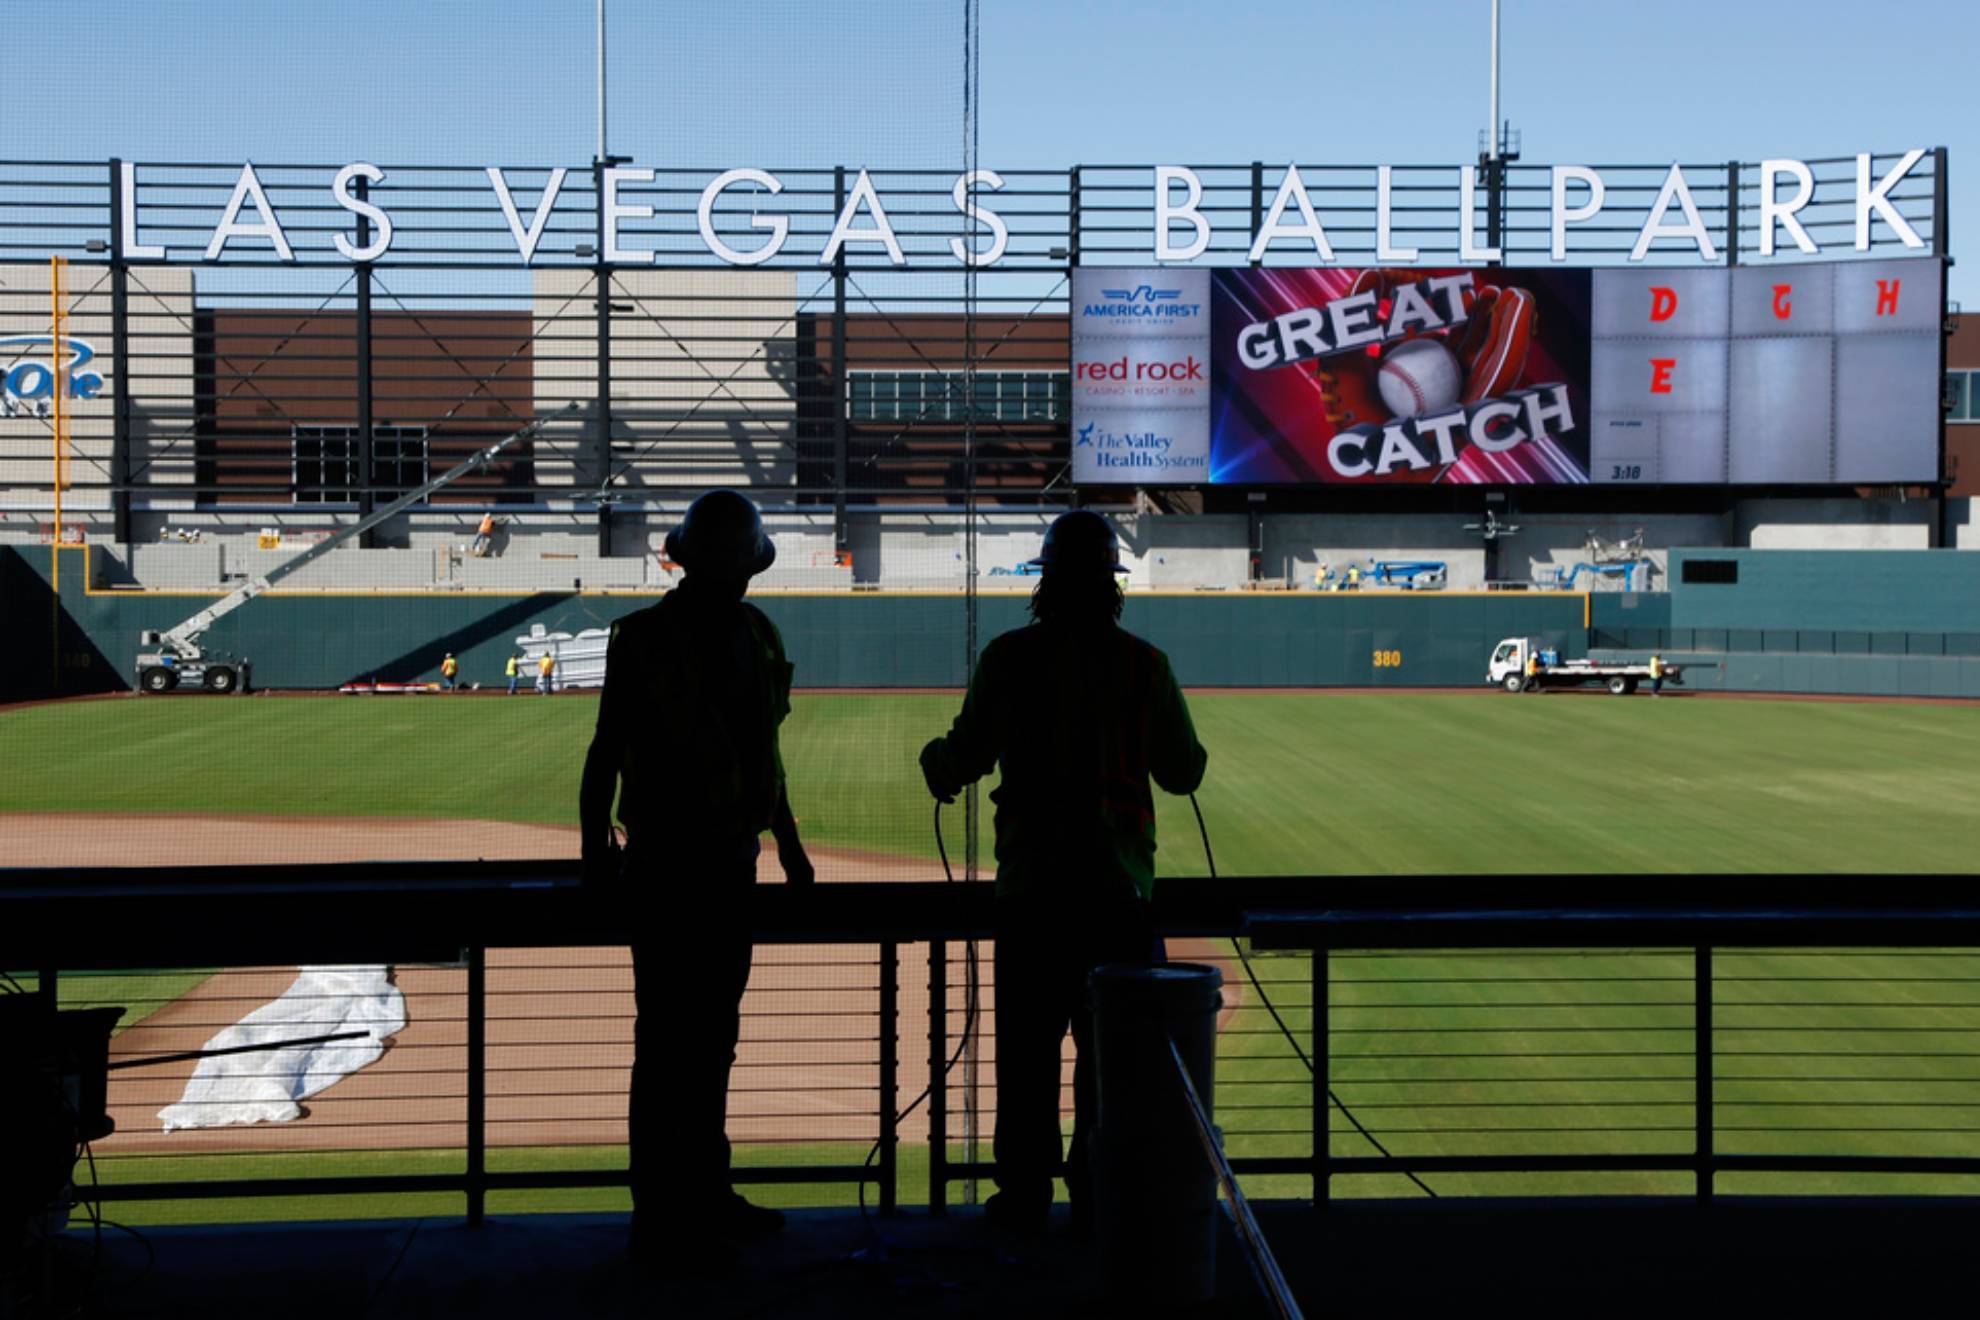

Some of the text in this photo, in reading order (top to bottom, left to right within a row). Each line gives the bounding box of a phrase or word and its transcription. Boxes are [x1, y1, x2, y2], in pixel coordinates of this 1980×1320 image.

[120, 148, 1928, 267] LAS VEGAS BALLPARK
[1083, 303, 1201, 317] AMERICA FIRST
[1648, 286, 1678, 323] D
[1771, 283, 1793, 321] G
[1876, 278, 1901, 317] H
[1237, 271, 1475, 371] GREAT
[1077, 354, 1203, 381] red rock
[1648, 358, 1677, 394] E
[1097, 430, 1172, 453] The Valley
[1327, 385, 1575, 478] CATCH
[1096, 452, 1153, 467] Health
[1611, 465, 1641, 480] 3:18
[1373, 650, 1401, 667] 380
